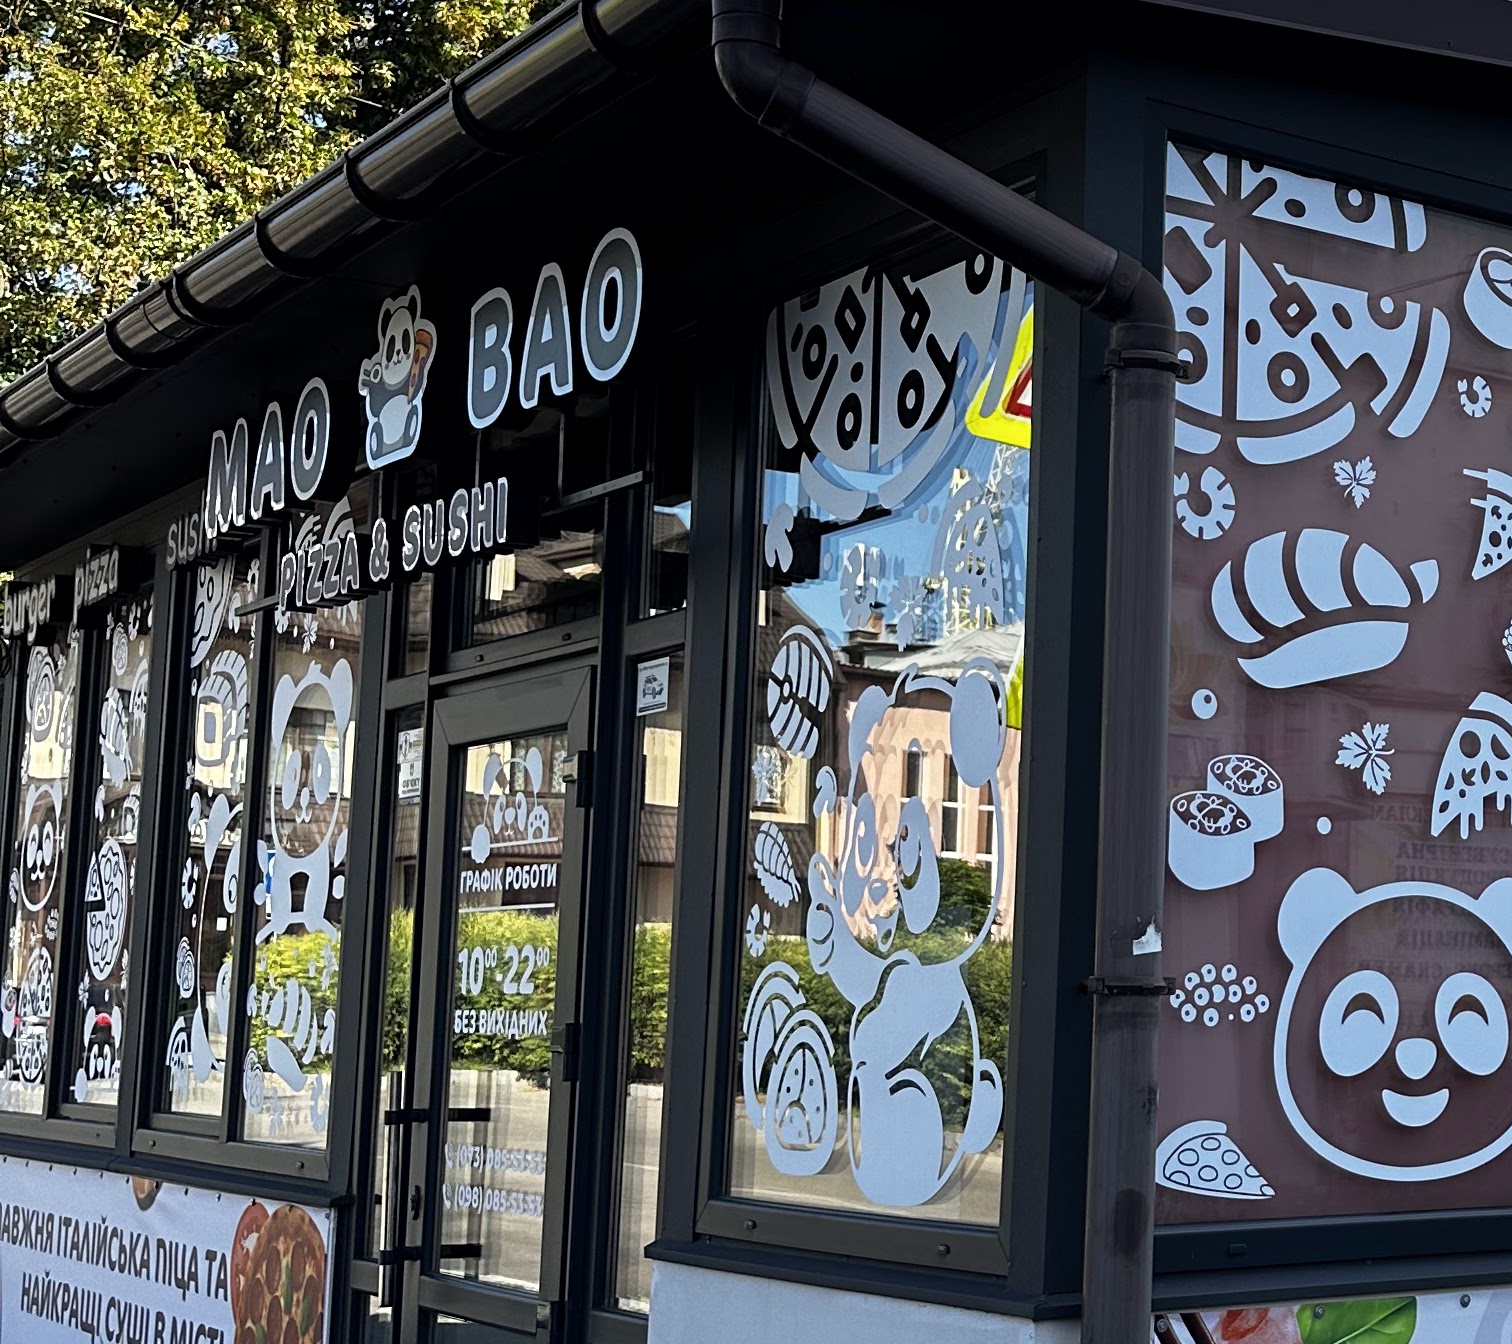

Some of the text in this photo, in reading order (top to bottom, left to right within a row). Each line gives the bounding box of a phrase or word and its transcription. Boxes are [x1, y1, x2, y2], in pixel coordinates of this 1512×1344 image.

[204, 227, 643, 539] MAO BAO
[279, 477, 508, 610] PIZZA & SUSHI
[3, 574, 57, 646] burger
[73, 543, 120, 627] pizza
[459, 863, 558, 894] ГРАФІК РОБОТИ
[454, 1008, 548, 1041] БЕЗ ВИХІДНИХ
[454, 1183, 483, 1215] (098)
[0, 1202, 229, 1302] АВЖНЯ ІТАЛІЙСЬКА ПІЦА ТА
